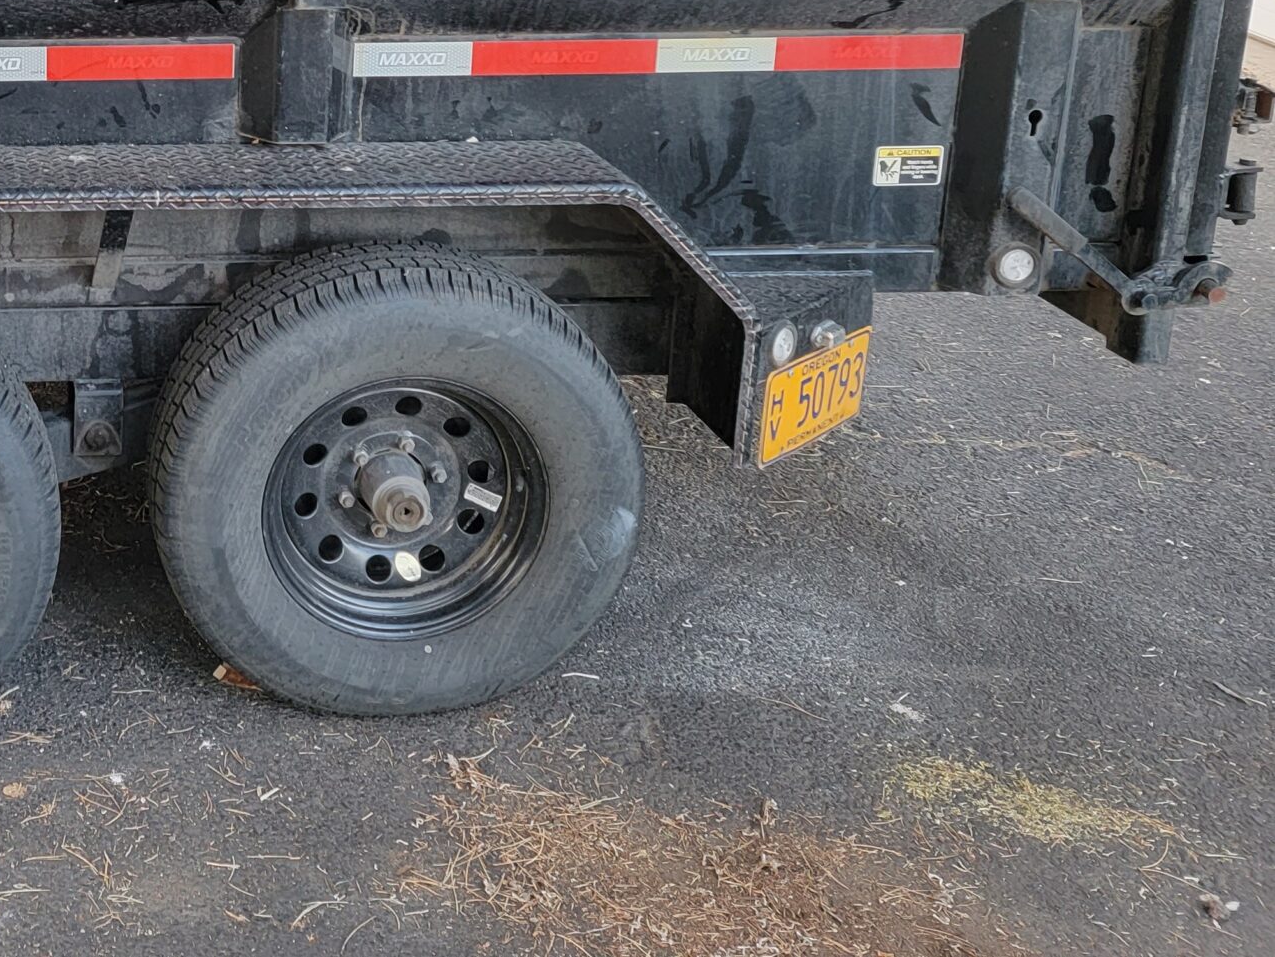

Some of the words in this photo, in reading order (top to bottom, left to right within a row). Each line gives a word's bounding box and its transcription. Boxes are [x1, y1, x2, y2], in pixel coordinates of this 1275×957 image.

[801, 348, 842, 375] OREGON
[797, 351, 864, 428] 50793
[787, 413, 840, 448] PERMANENT
